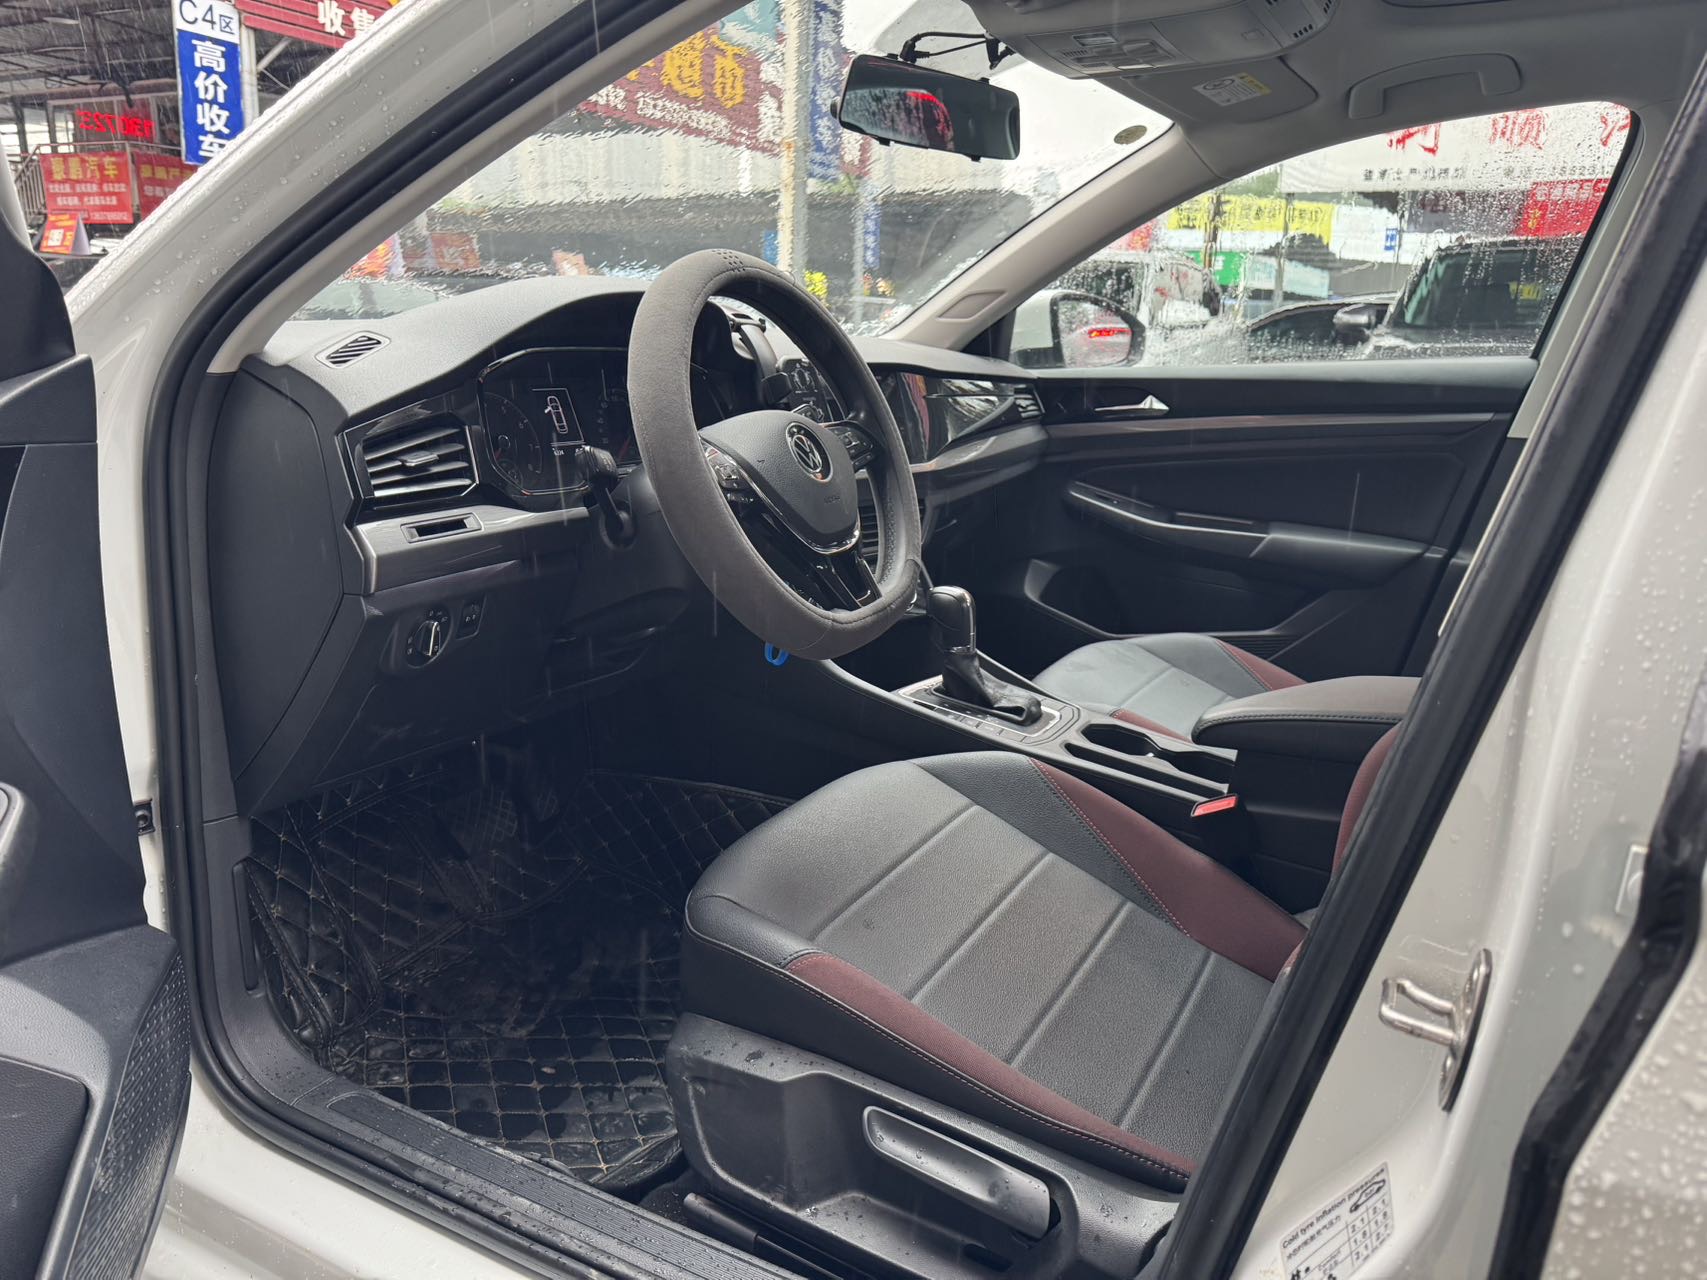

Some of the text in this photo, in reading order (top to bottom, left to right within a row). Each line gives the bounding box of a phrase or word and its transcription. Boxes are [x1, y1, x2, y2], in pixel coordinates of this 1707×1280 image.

[192, 39, 231, 158] 高价收车
[1282, 1232, 1300, 1249] Cold
[1300, 1221, 1315, 1236] tyre
[1347, 1168, 1385, 1201] pressures
